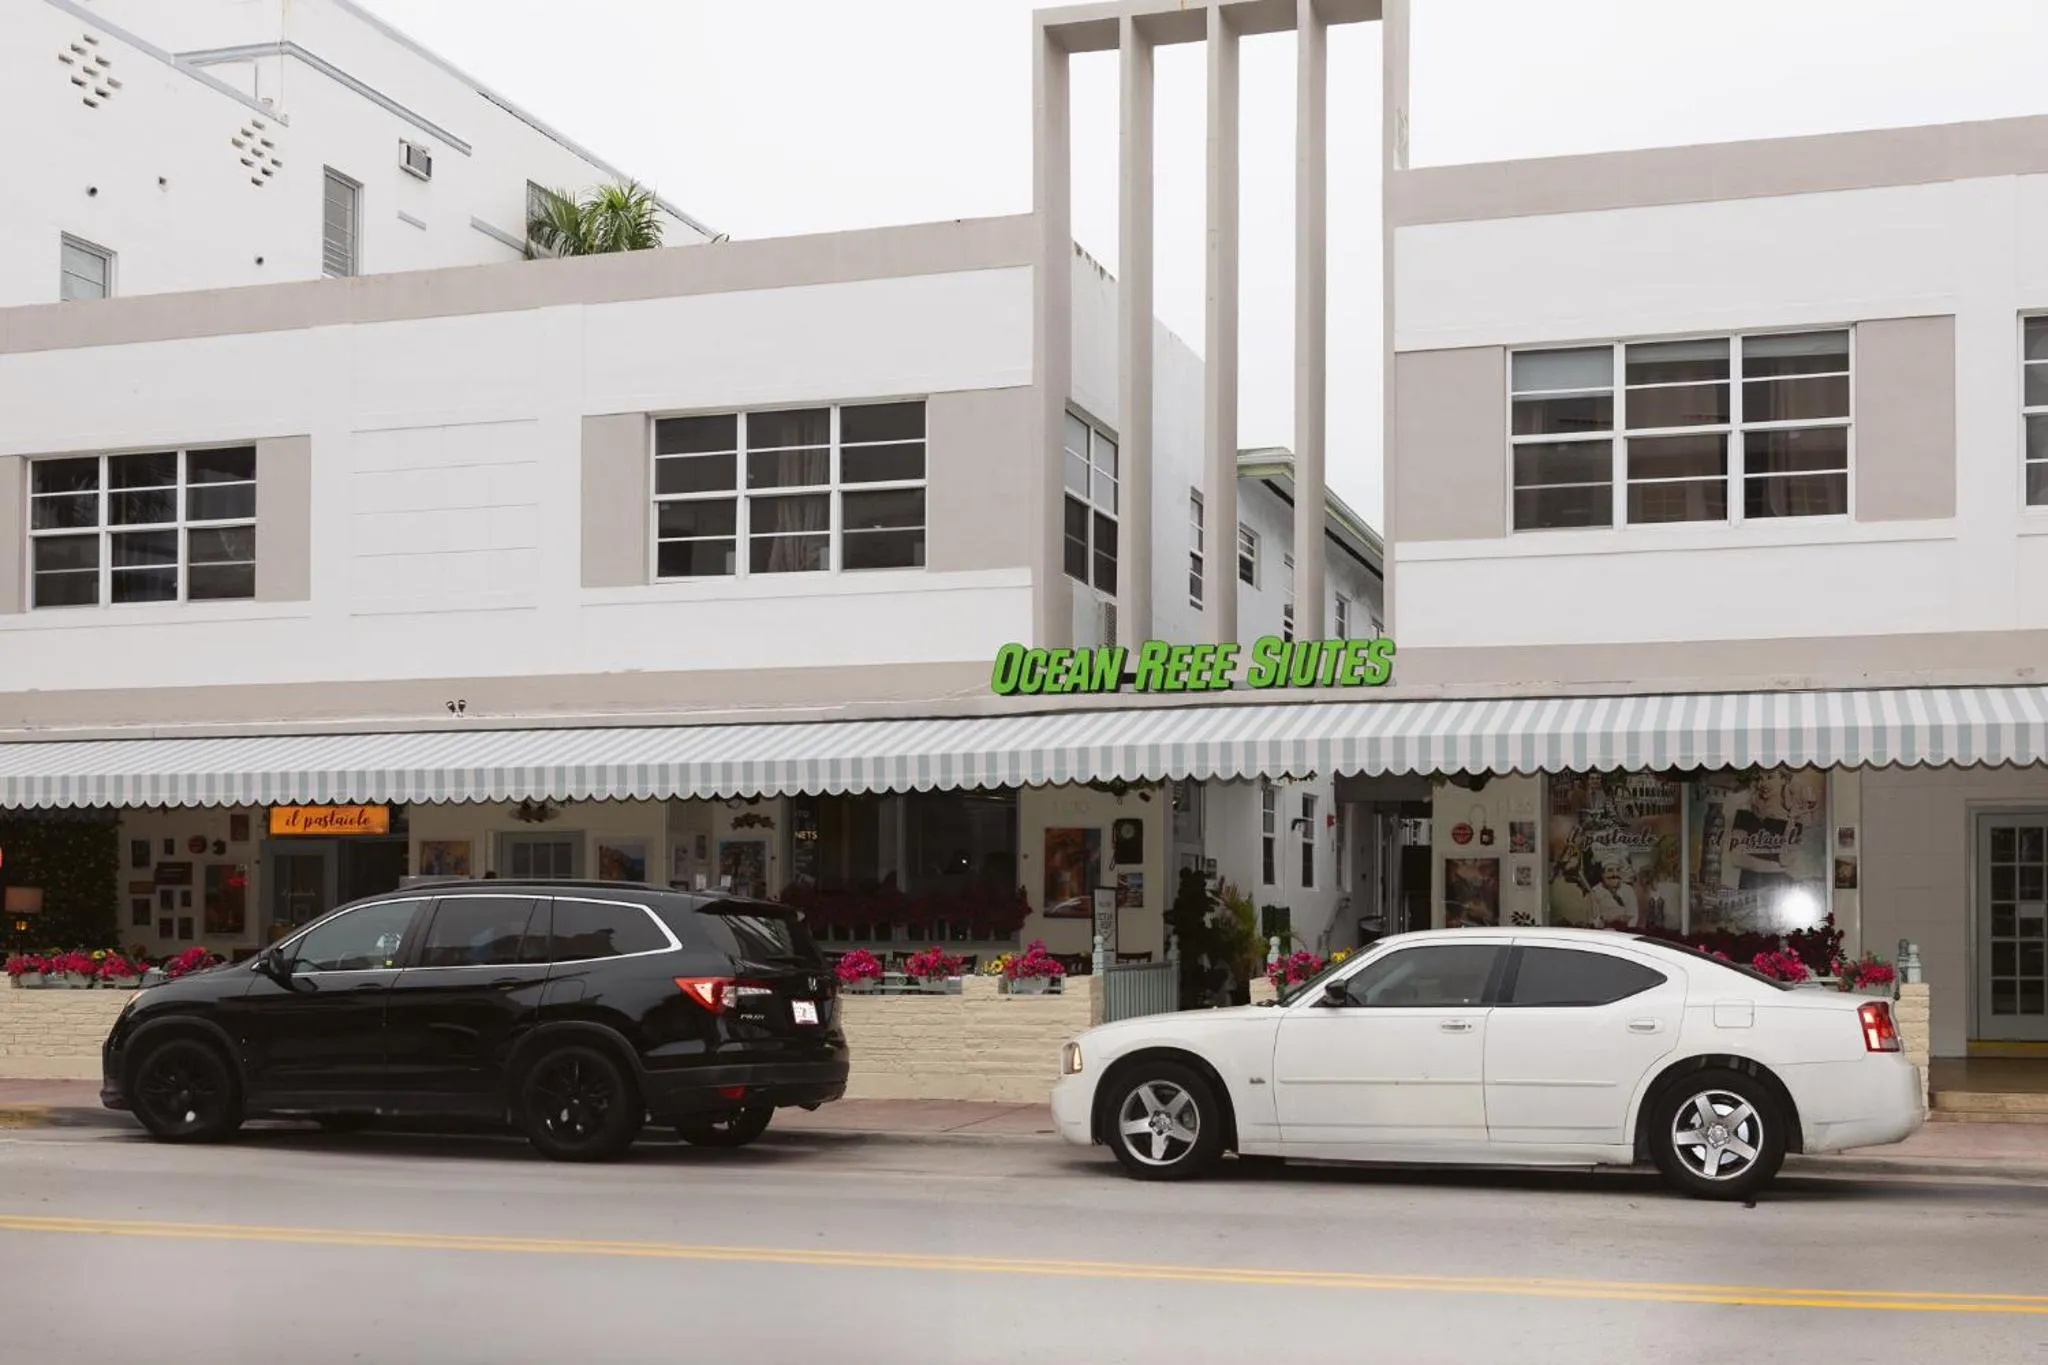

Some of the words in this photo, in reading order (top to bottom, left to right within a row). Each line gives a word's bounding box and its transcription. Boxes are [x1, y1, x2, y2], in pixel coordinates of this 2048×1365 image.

[992, 641, 1128, 695] OCEAN
[1134, 639, 1240, 692] REEE
[1248, 636, 1396, 688] SIUTES
[285, 809, 300, 826] il
